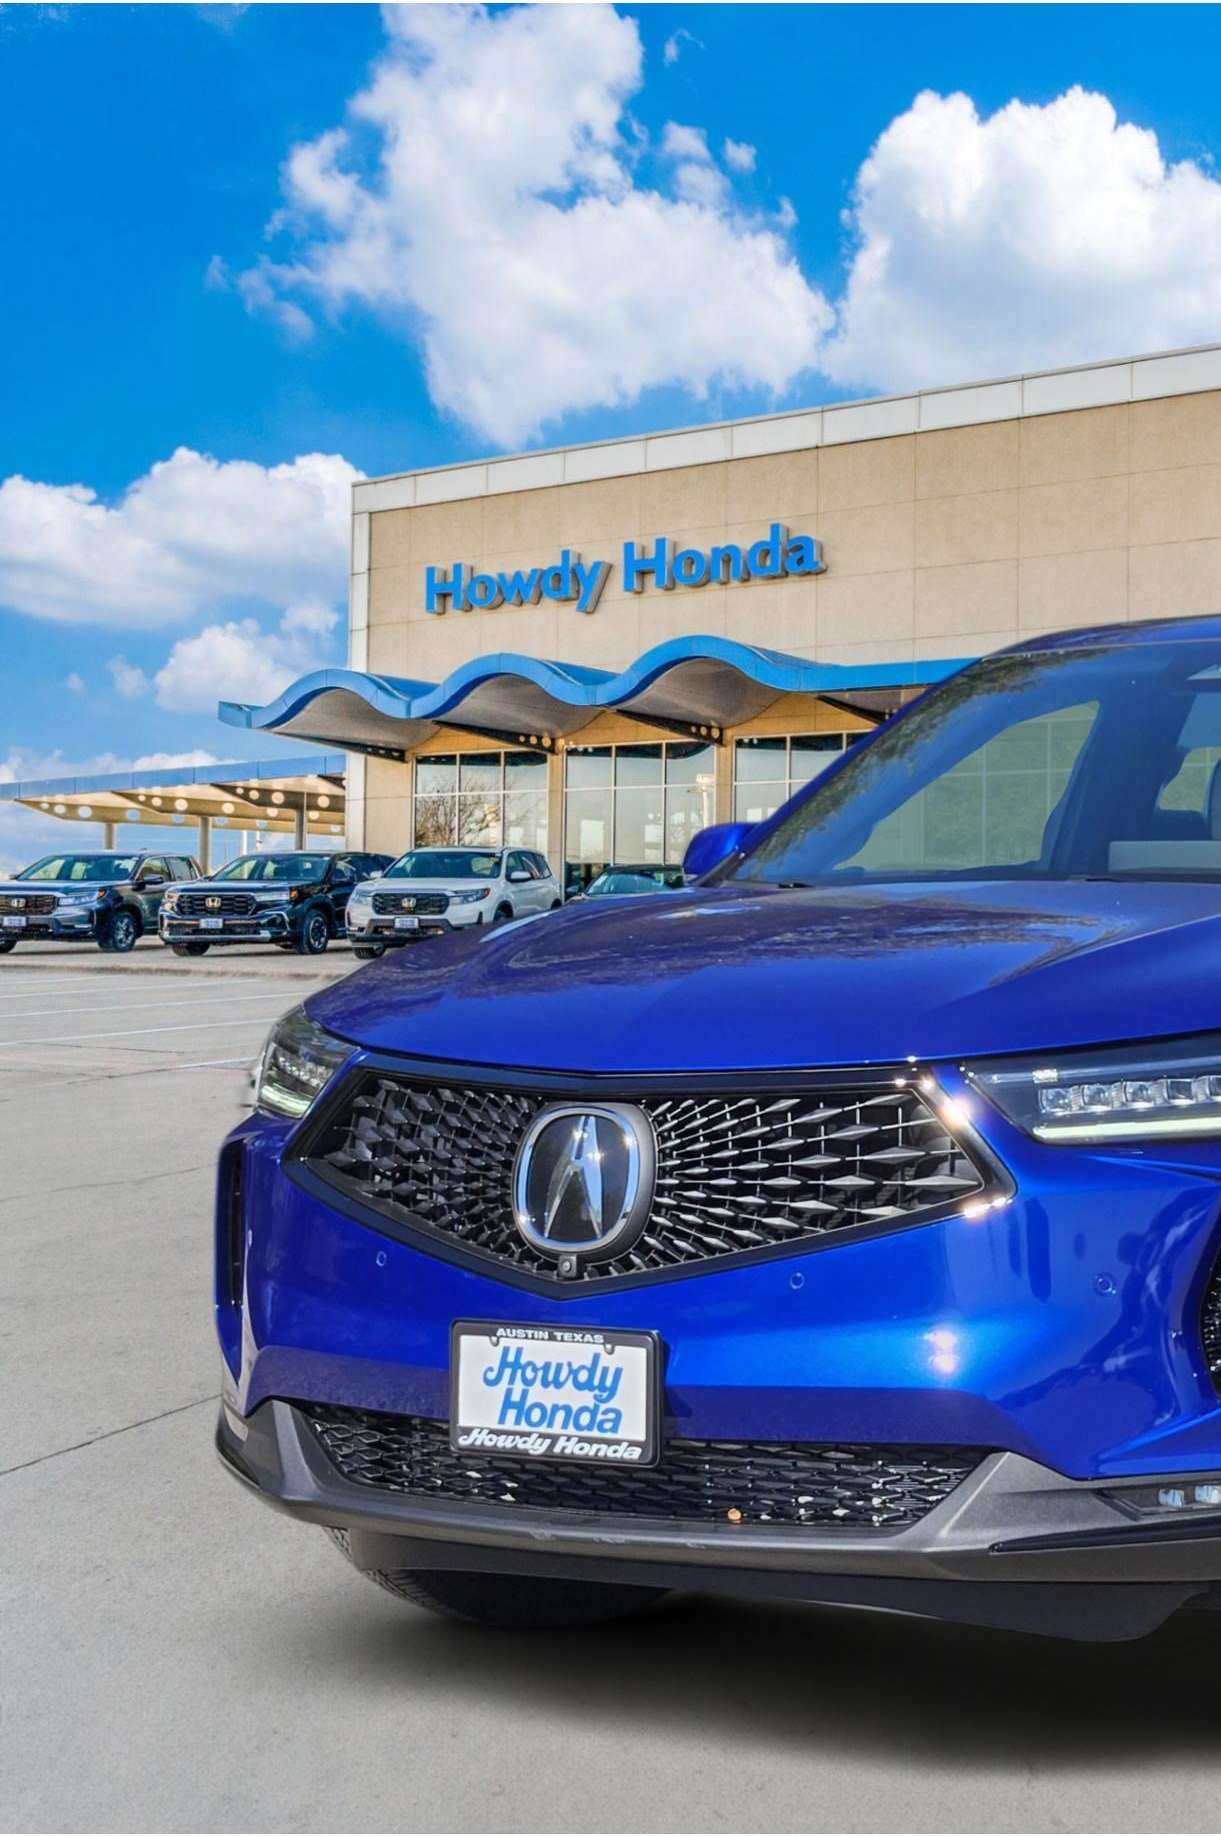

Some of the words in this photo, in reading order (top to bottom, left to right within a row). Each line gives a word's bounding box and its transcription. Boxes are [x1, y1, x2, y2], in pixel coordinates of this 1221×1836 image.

[425, 549, 612, 615] Howdy
[622, 522, 827, 594] Honda
[496, 1327, 549, 1340] AUSTIN
[555, 1331, 605, 1344] TEXAS
[483, 1345, 624, 1404] Howdy
[497, 1387, 623, 1435] Honda
[457, 1427, 552, 1456] Howdy
[552, 1435, 643, 1461] Honda
